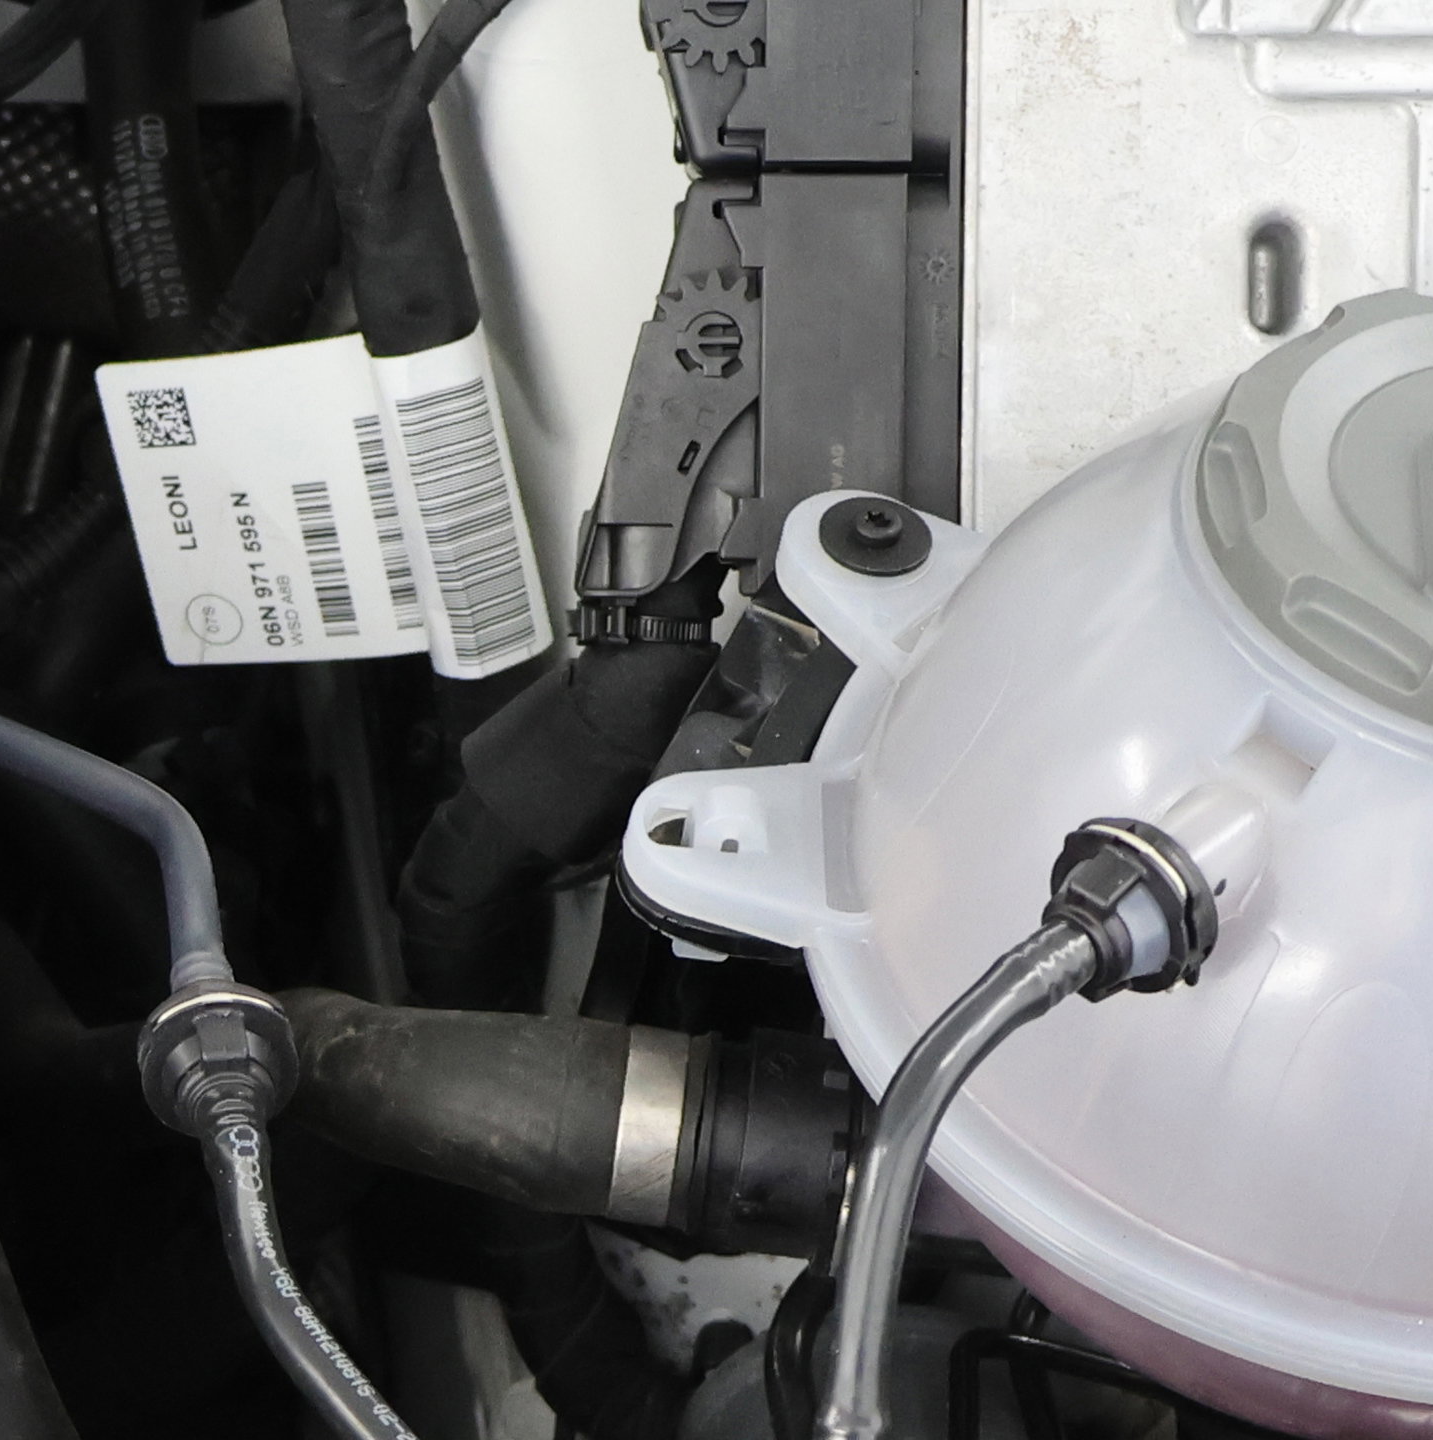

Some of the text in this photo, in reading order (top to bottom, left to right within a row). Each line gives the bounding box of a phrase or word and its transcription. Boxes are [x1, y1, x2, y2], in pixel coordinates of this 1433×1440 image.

[162, 475, 198, 551] LEONI
[231, 492, 285, 647] 06N 971 595 N
